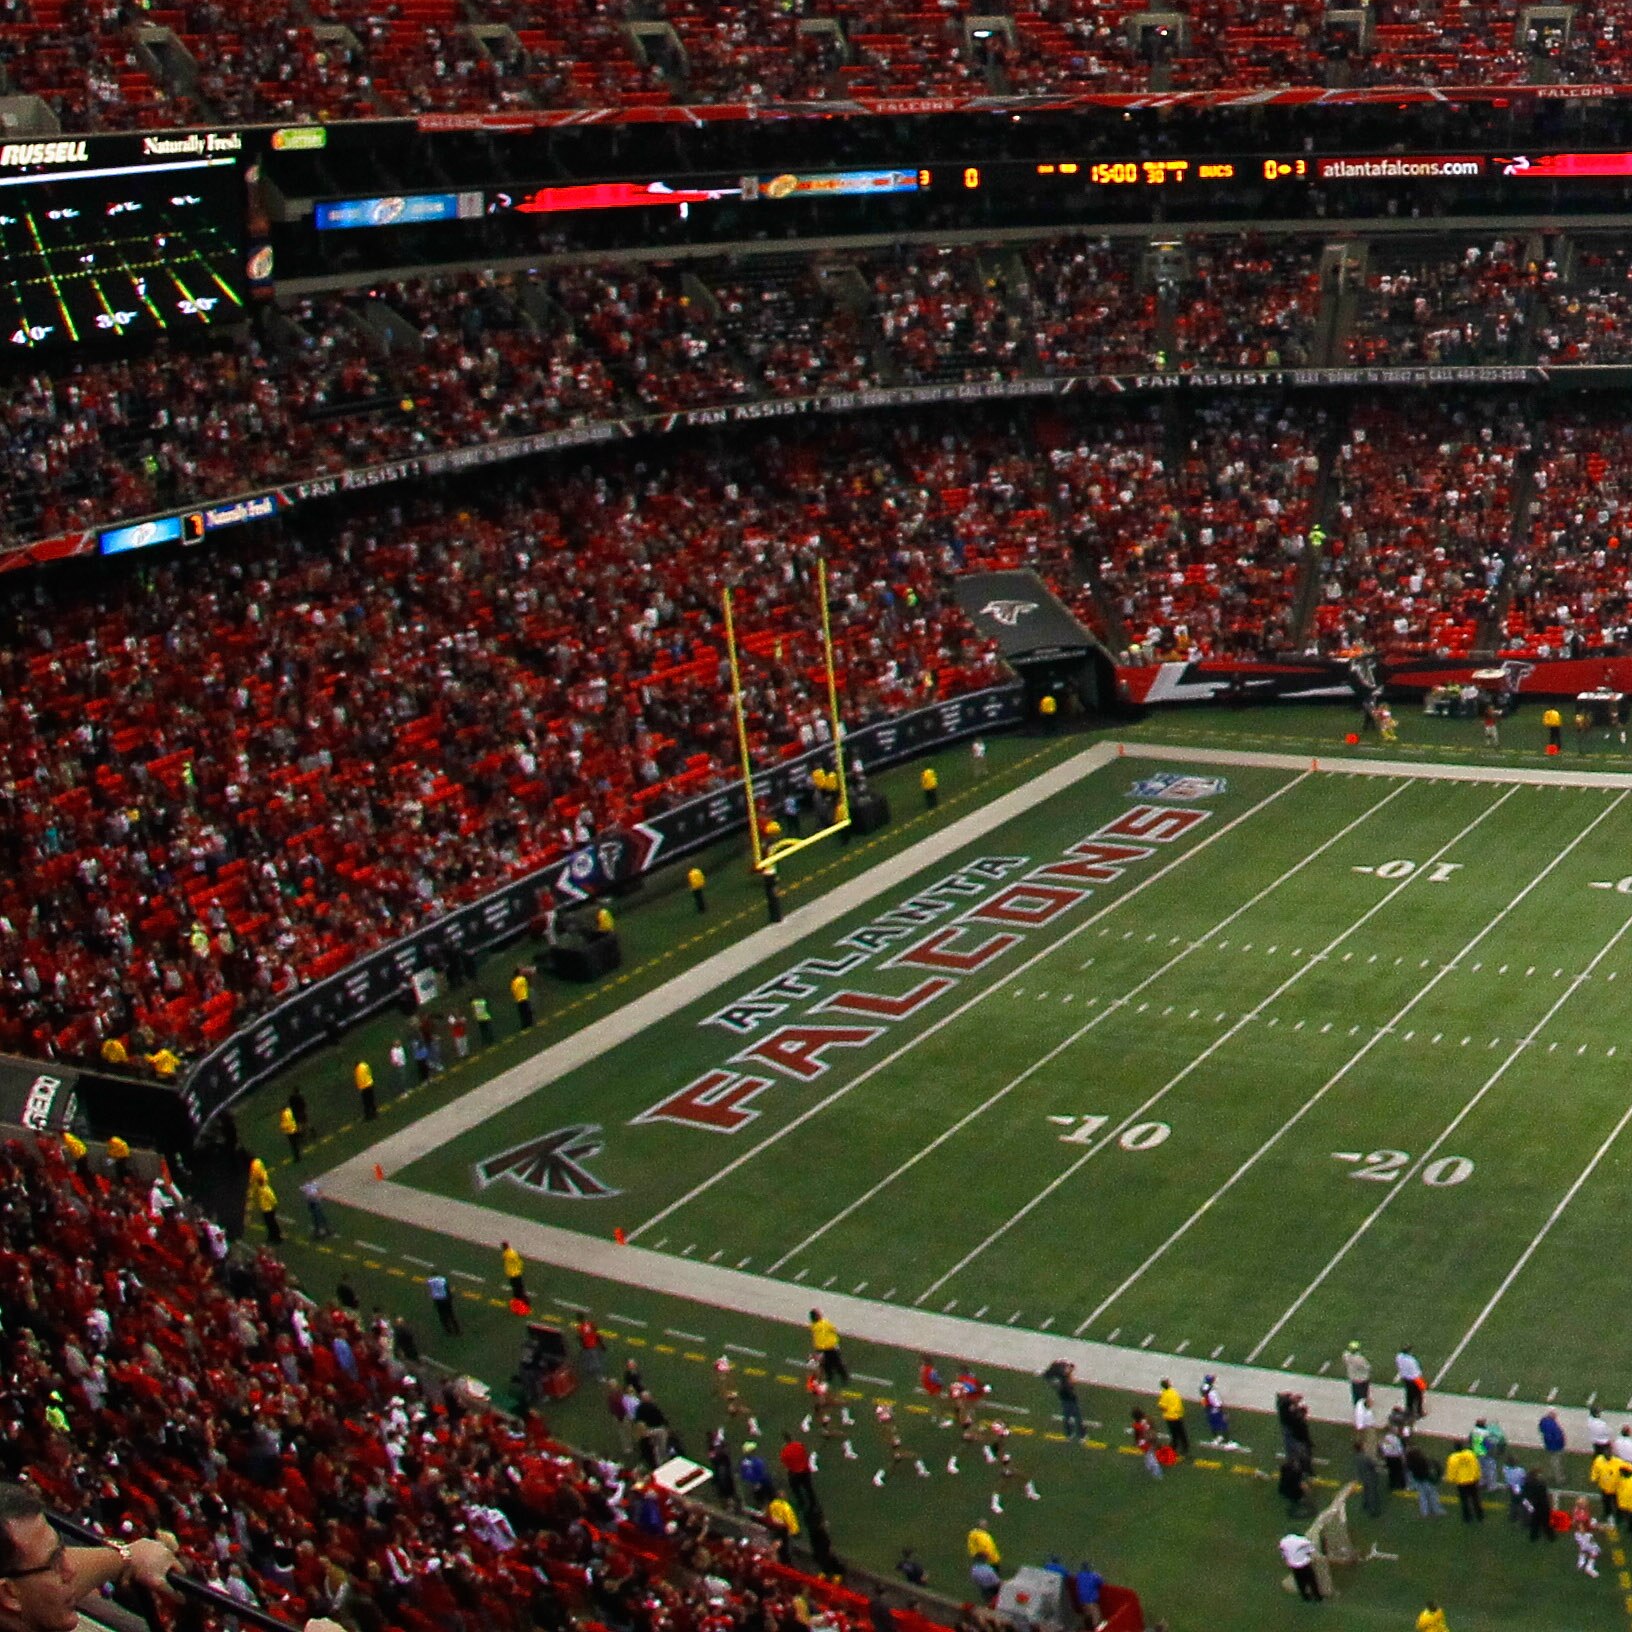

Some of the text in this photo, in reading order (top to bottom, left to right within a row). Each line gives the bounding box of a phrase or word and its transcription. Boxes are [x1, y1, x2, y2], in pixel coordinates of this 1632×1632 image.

[1537, 87, 1615, 98] FALCONS
[876, 102, 955, 112] FALCONS
[1, 141, 88, 166] RUSSELL
[144, 133, 241, 155] Naturally Fresh
[1091, 164, 1137, 183] 15:00
[1199, 165, 1234, 177] BUCS
[1264, 159, 1277, 180] 0
[1296, 159, 1306, 174] 3
[1323, 159, 1478, 179] atlantafalcons.com
[920, 169, 930, 186] 3
[965, 168, 978, 188] 0
[178, 299, 213, 315] 20
[96, 311, 131, 329] 30
[11, 325, 46, 344] 40
[1136, 376, 1178, 387] FAN
[688, 409, 727, 424] FAN
[298, 480, 335, 499] FAN
[1376, 860, 1464, 883] 10
[700, 855, 1031, 1034] ATLANTA
[628, 804, 1213, 1134] FALCONS
[22, 1075, 61, 1130] GEICO
[1057, 1114, 1172, 1151] 10
[1348, 1149, 1476, 1186] 20
